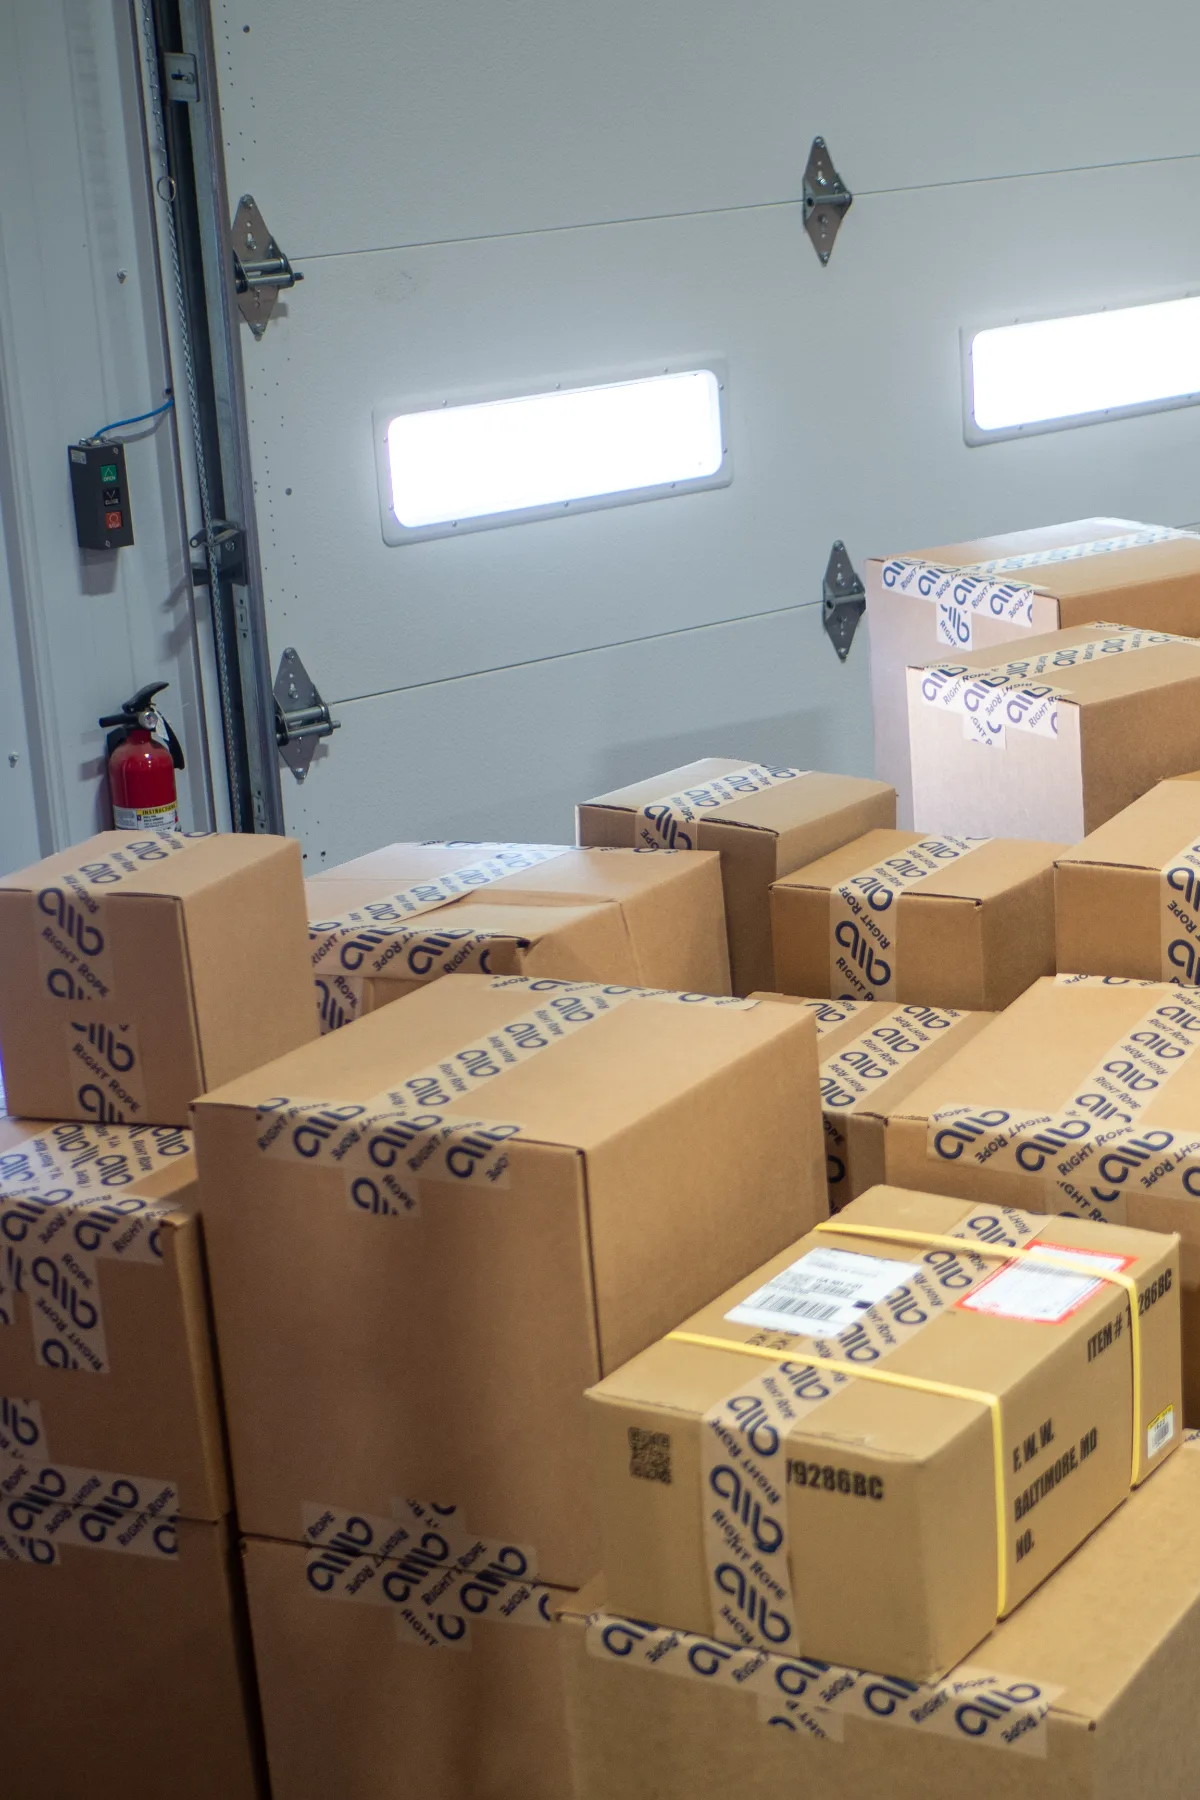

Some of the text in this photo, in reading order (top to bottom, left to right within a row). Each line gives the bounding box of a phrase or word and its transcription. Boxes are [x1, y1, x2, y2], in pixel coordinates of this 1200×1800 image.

[900, 566, 918, 591] RIGHT
[935, 579, 951, 600] ROPE
[971, 586, 990, 610] RIGHT
[1008, 599, 1024, 619] ROPE
[939, 620, 958, 648] RIGHT
[943, 672, 991, 705] RIGHT ROPE
[985, 695, 1002, 716] ROPE
[1028, 704, 1049, 728] RIGHT
[838, 886, 890, 949] RIGHT ROPE
[1167, 900, 1198, 934] ROPE
[42, 927, 79, 963] RIGHT
[77, 963, 110, 997] ROPE
[373, 943, 401, 971] ROPE
[443, 941, 475, 974] RIGHT
[836, 956, 866, 992] RIGHT
[333, 975, 358, 1008] ROPE
[1147, 1018, 1193, 1046] RIGHT ROPE
[72, 1043, 140, 1113] RIGHT ROPE
[1142, 1058, 1168, 1076] RIGHT
[1093, 1076, 1142, 1110] RIGHT ROPE
[933, 1106, 973, 1122] ROPE
[257, 1113, 288, 1151] RIGHT
[975, 1115, 1051, 1165] RIGHT ROPE
[407, 1132, 441, 1172] RIGHT
[1057, 1126, 1134, 1177] RIGHT ROPE
[1140, 1157, 1174, 1189] ROPE
[381, 1174, 416, 1210] ROPE
[112, 1217, 144, 1252] RIGHT
[1008, 1214, 1031, 1235] RIGHT
[62, 1253, 93, 1289] ROPE
[921, 1277, 944, 1308] RIGHT
[1088, 1321, 1113, 1363] ITEM
[709, 1417, 781, 1505] RIGHT ROPE
[1014, 1426, 1097, 1522] BALTIMORE, MD
[1015, 1528, 1035, 1563] NO.
[750, 1561, 787, 1600] ROPE
[401, 1608, 440, 1647] RIGHT
[720, 1605, 754, 1644] ROPE
[645, 1634, 680, 1664] ROPE
[819, 1675, 857, 1703] ROPE
[909, 1689, 949, 1724] RIGHT
